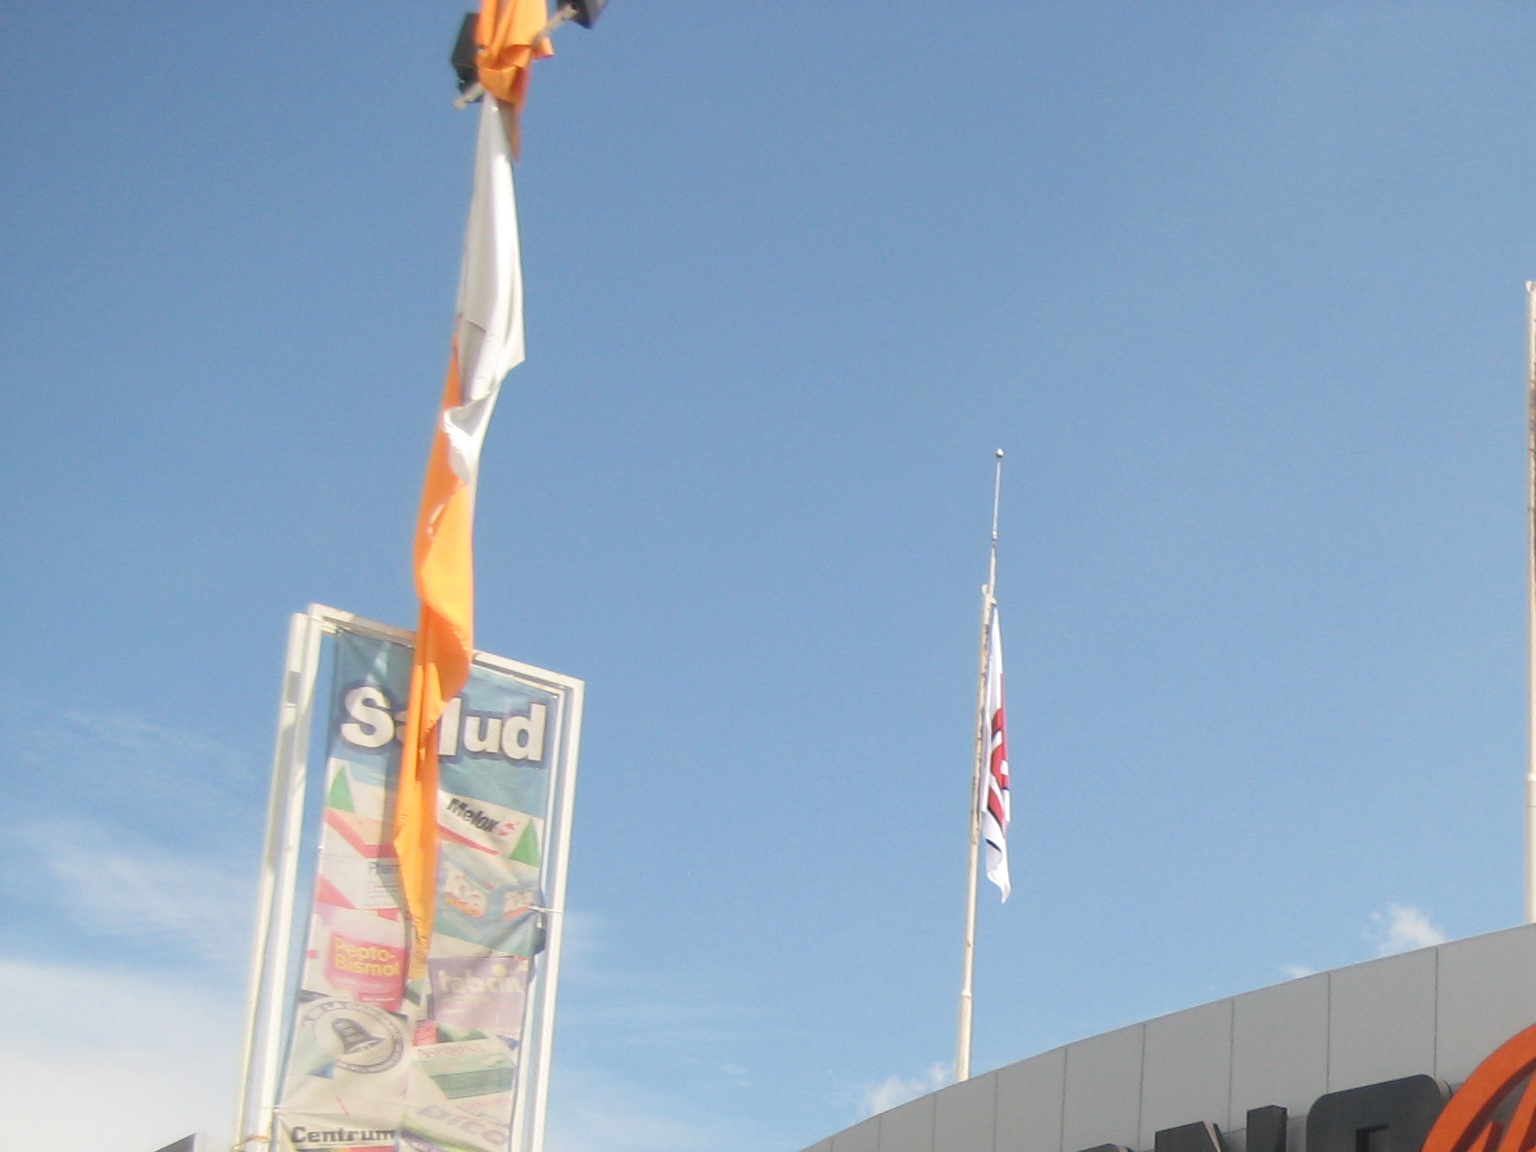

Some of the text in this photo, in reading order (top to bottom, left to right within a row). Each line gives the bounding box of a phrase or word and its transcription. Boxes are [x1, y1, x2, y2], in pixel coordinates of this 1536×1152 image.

[340, 685, 547, 762] Slud
[446, 797, 500, 833] Melox
[290, 1126, 396, 1144] Centrum
